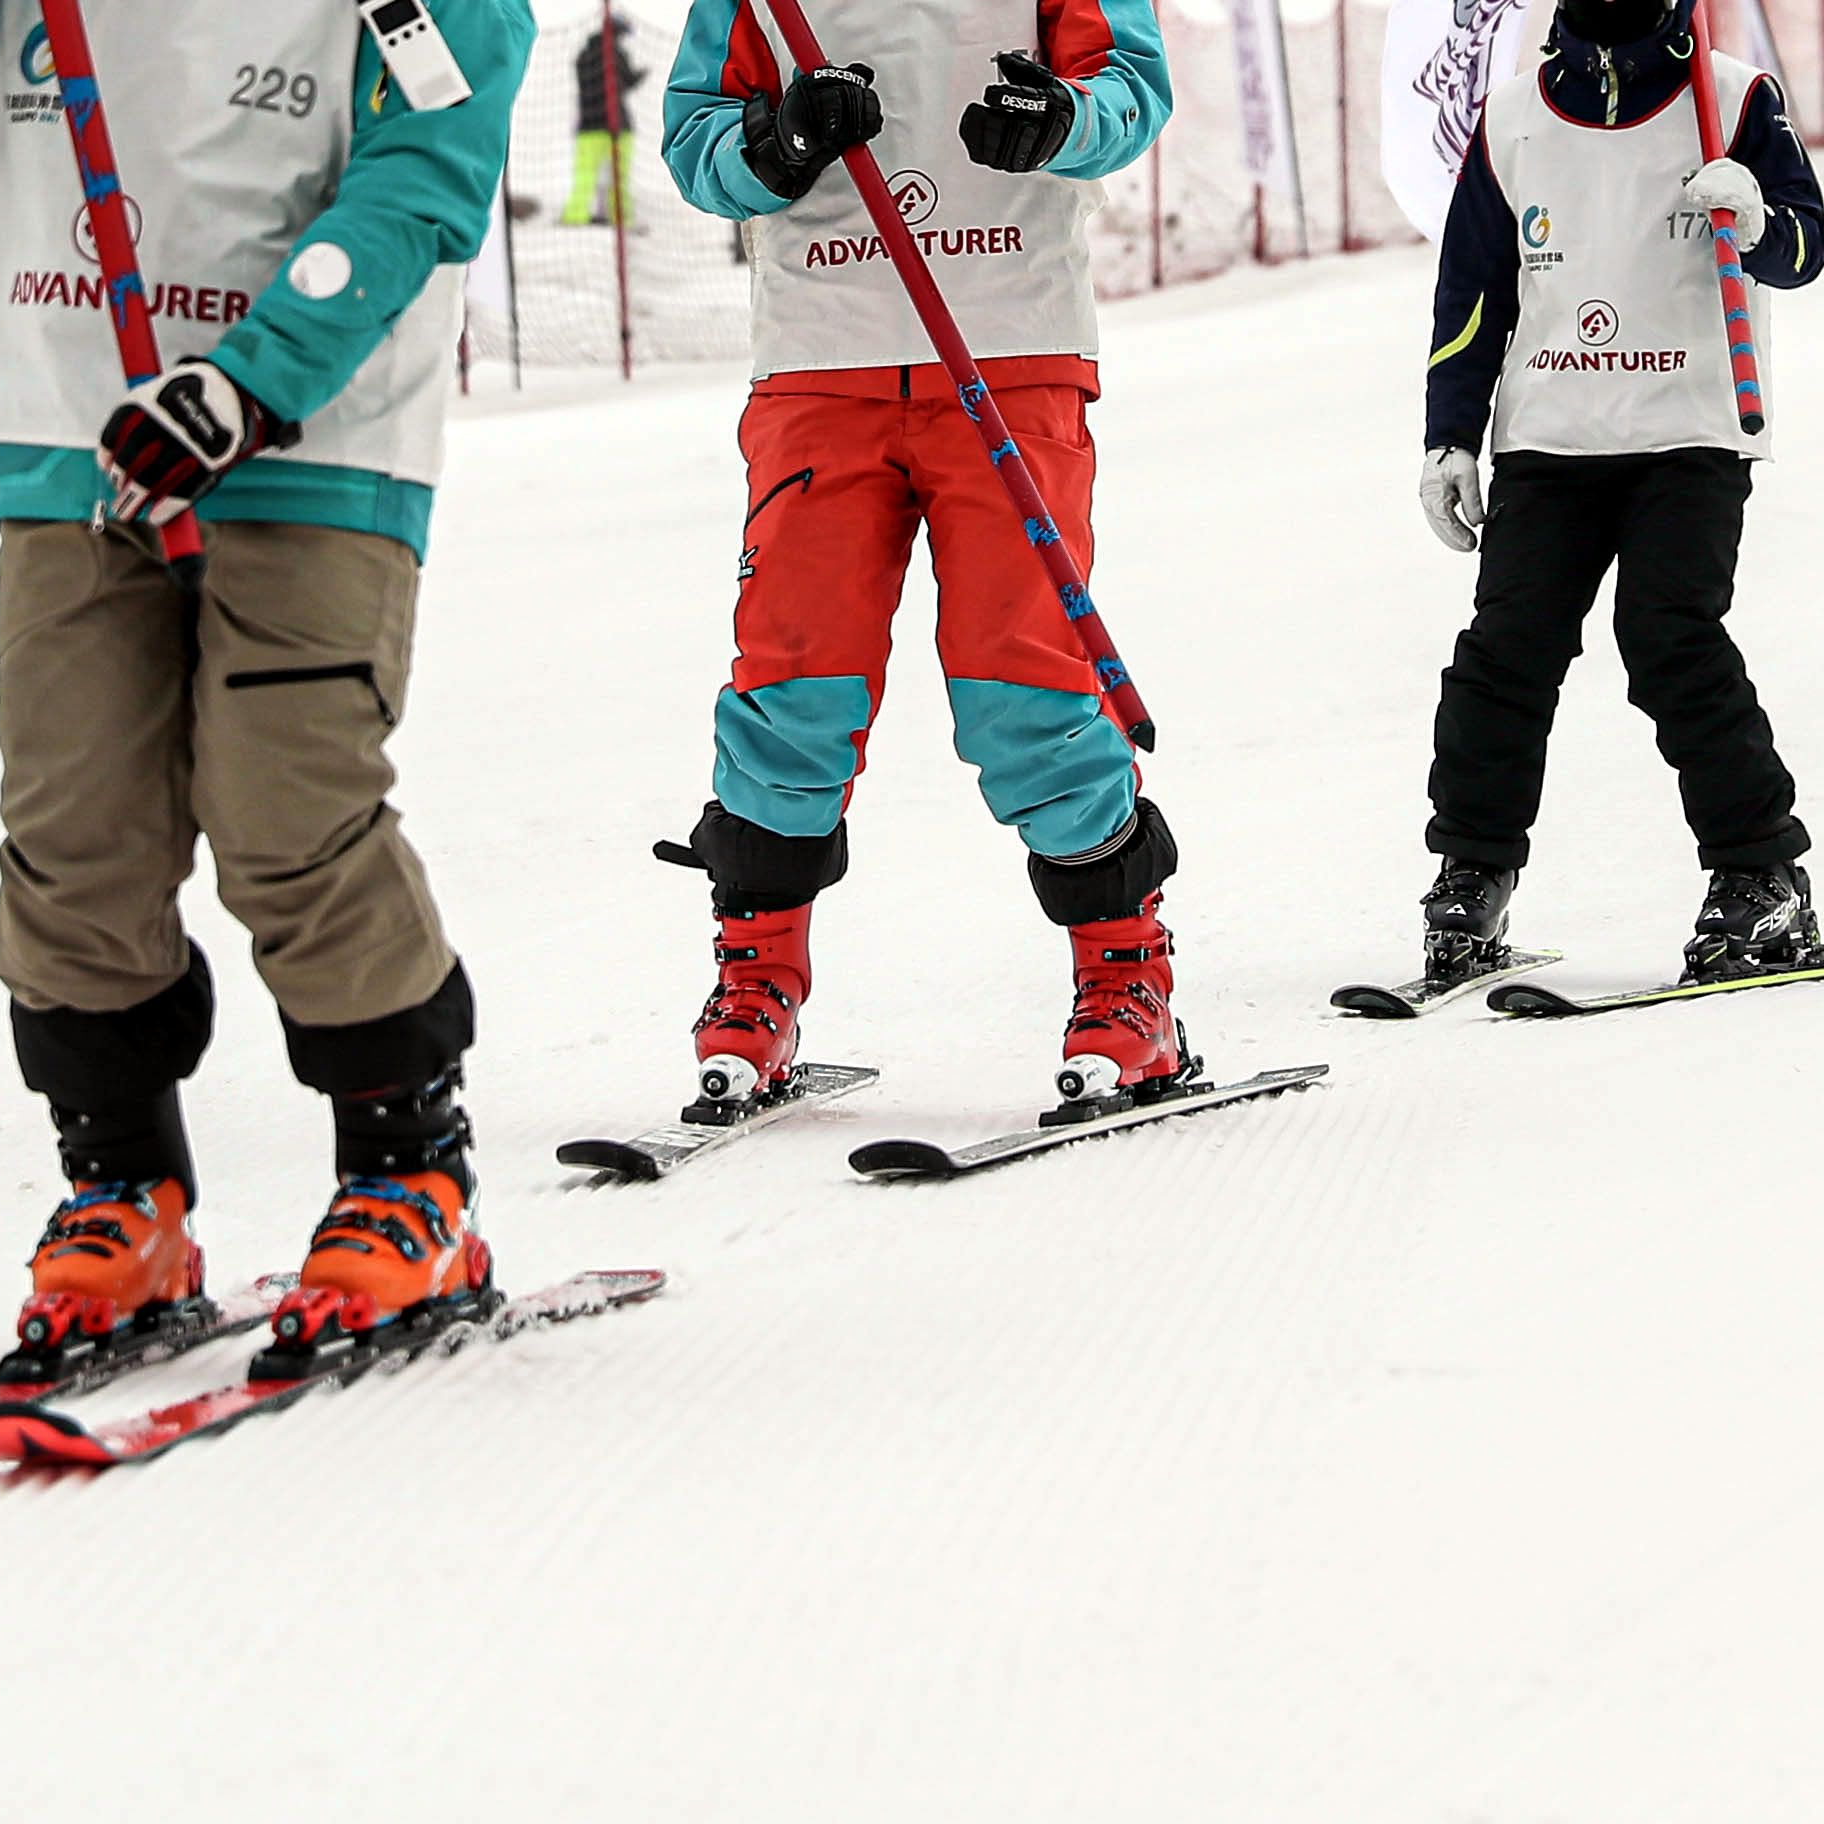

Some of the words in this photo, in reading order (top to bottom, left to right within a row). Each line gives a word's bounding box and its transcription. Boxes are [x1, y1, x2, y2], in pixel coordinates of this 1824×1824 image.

[229, 64, 318, 119] 229
[806, 226, 1024, 269] ADVATURER
[11, 272, 251, 324] ADVANURER
